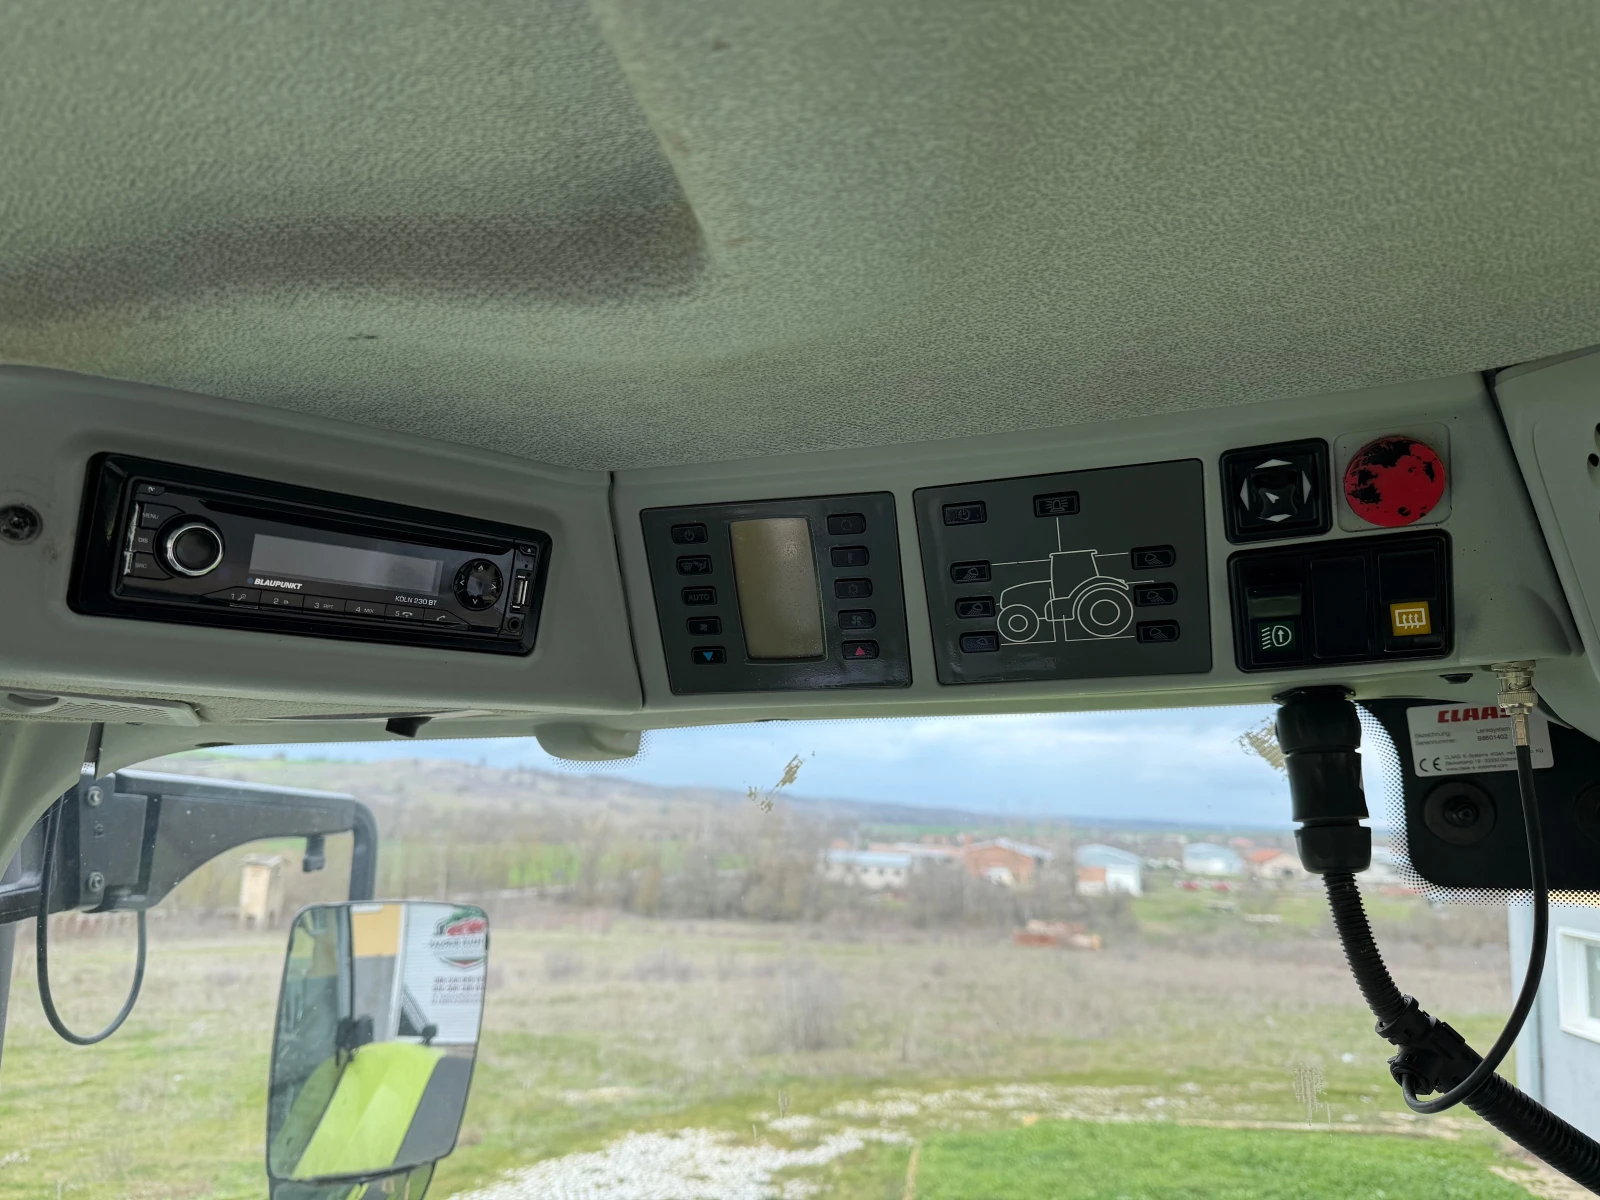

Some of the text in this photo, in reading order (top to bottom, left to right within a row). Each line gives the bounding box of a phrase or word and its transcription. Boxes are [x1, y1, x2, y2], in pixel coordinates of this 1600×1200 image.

[254, 578, 302, 590] BLAUPUNKT
[394, 595, 413, 604] KÖLN
[414, 597, 428, 605] 230
[688, 593, 710, 601] AUTO
[1475, 726, 1511, 734] Lenksystem
